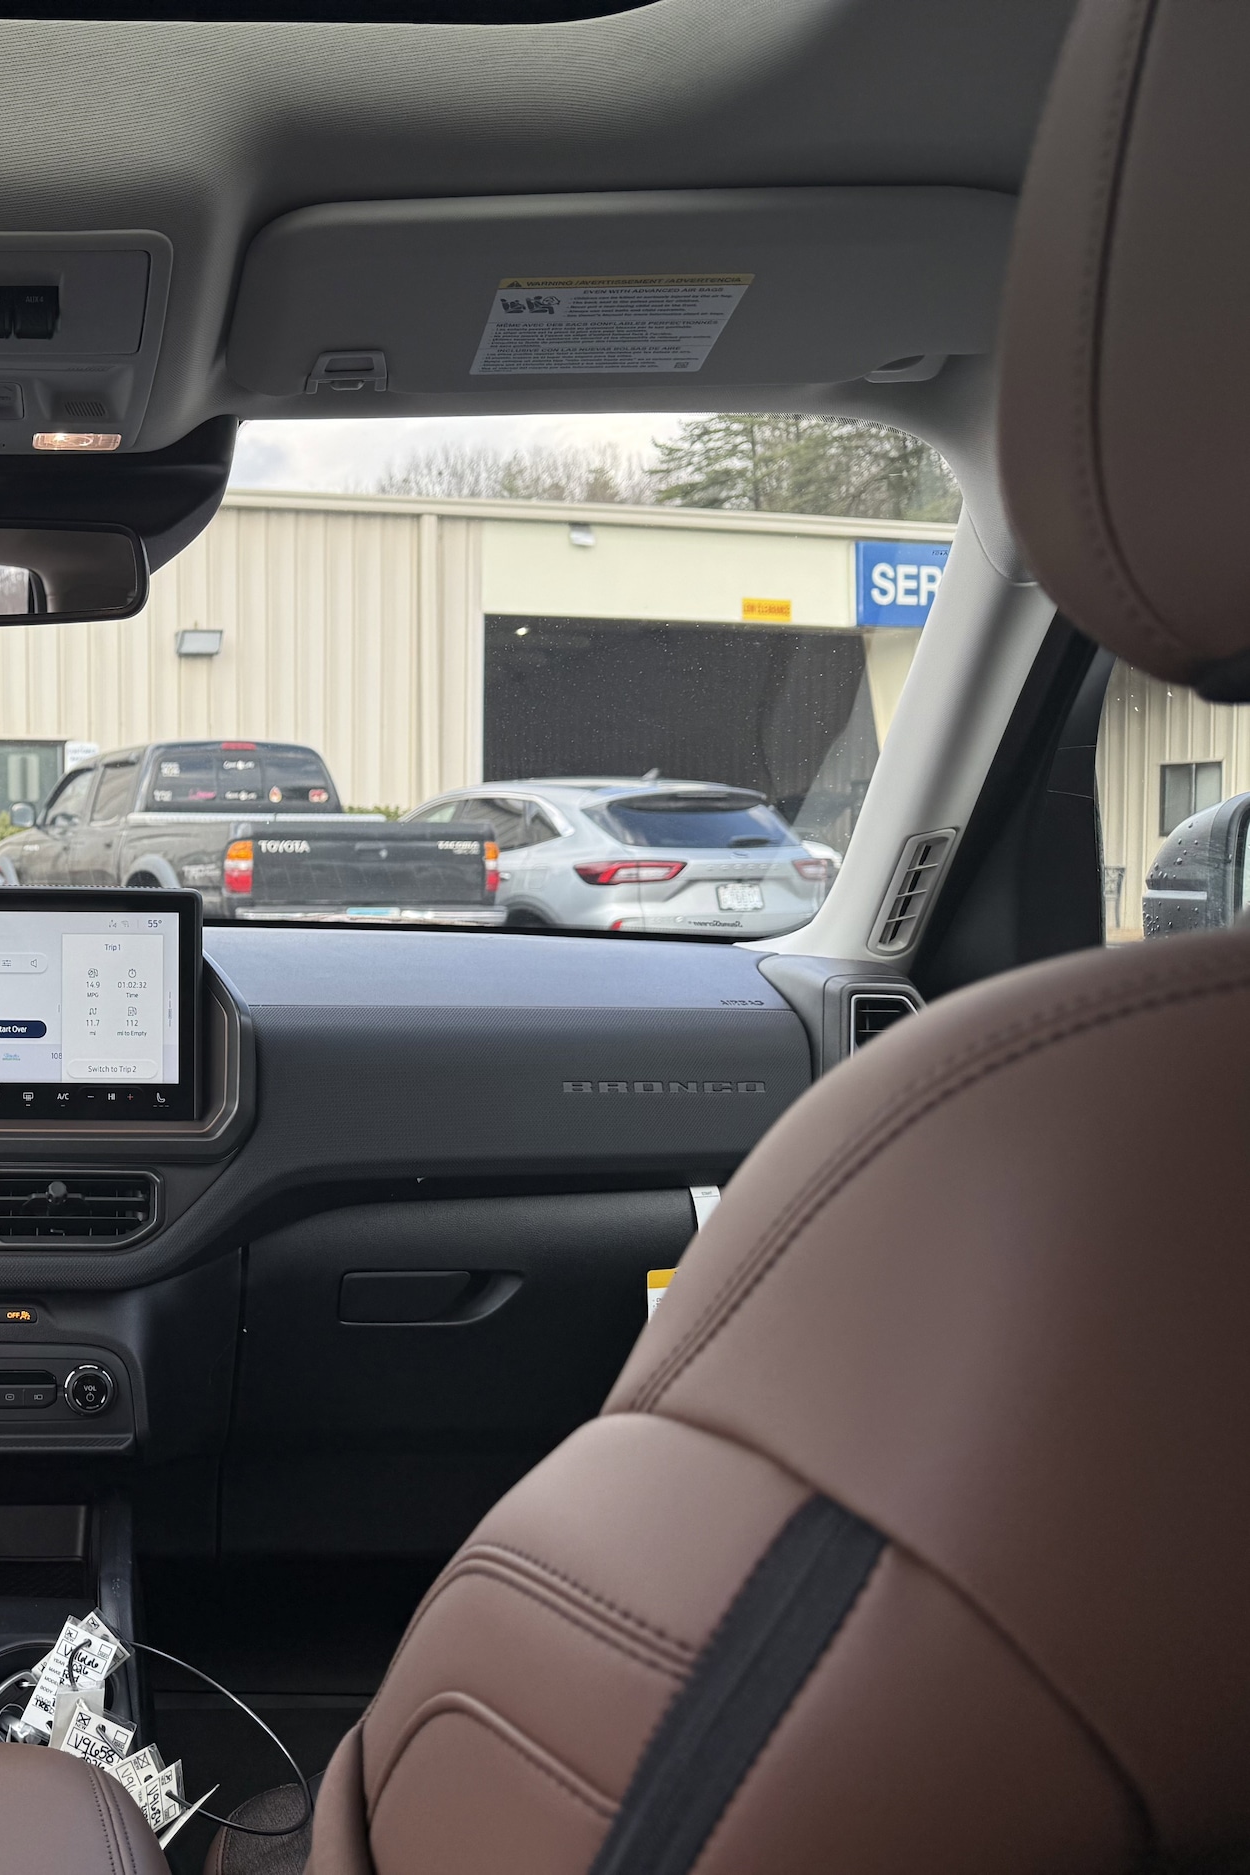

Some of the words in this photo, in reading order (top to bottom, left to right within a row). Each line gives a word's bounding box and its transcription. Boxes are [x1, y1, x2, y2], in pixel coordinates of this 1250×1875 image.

[258, 839, 311, 854] TOYOTA
[147, 919, 163, 929] 55°
[104, 943, 118, 952] Trip
[86, 981, 101, 989] 14.9
[117, 981, 148, 989] 01:02:32
[86, 1019, 100, 1027] 11.7
[126, 1019, 139, 1027] 112
[12, 1025, 27, 1033] Over
[130, 1030, 148, 1038] Empty
[88, 1065, 110, 1073] Switch
[118, 1065, 132, 1074] Trip
[562, 1080, 767, 1093] BRONCO
[57, 1092, 70, 1101] A/C
[107, 1093, 116, 1101] HI
[6, 1311, 21, 1319] OFF
[83, 1384, 97, 1392] VOL
[75, 1723, 87, 1731] NEW
[75, 1733, 115, 1764] V9658
